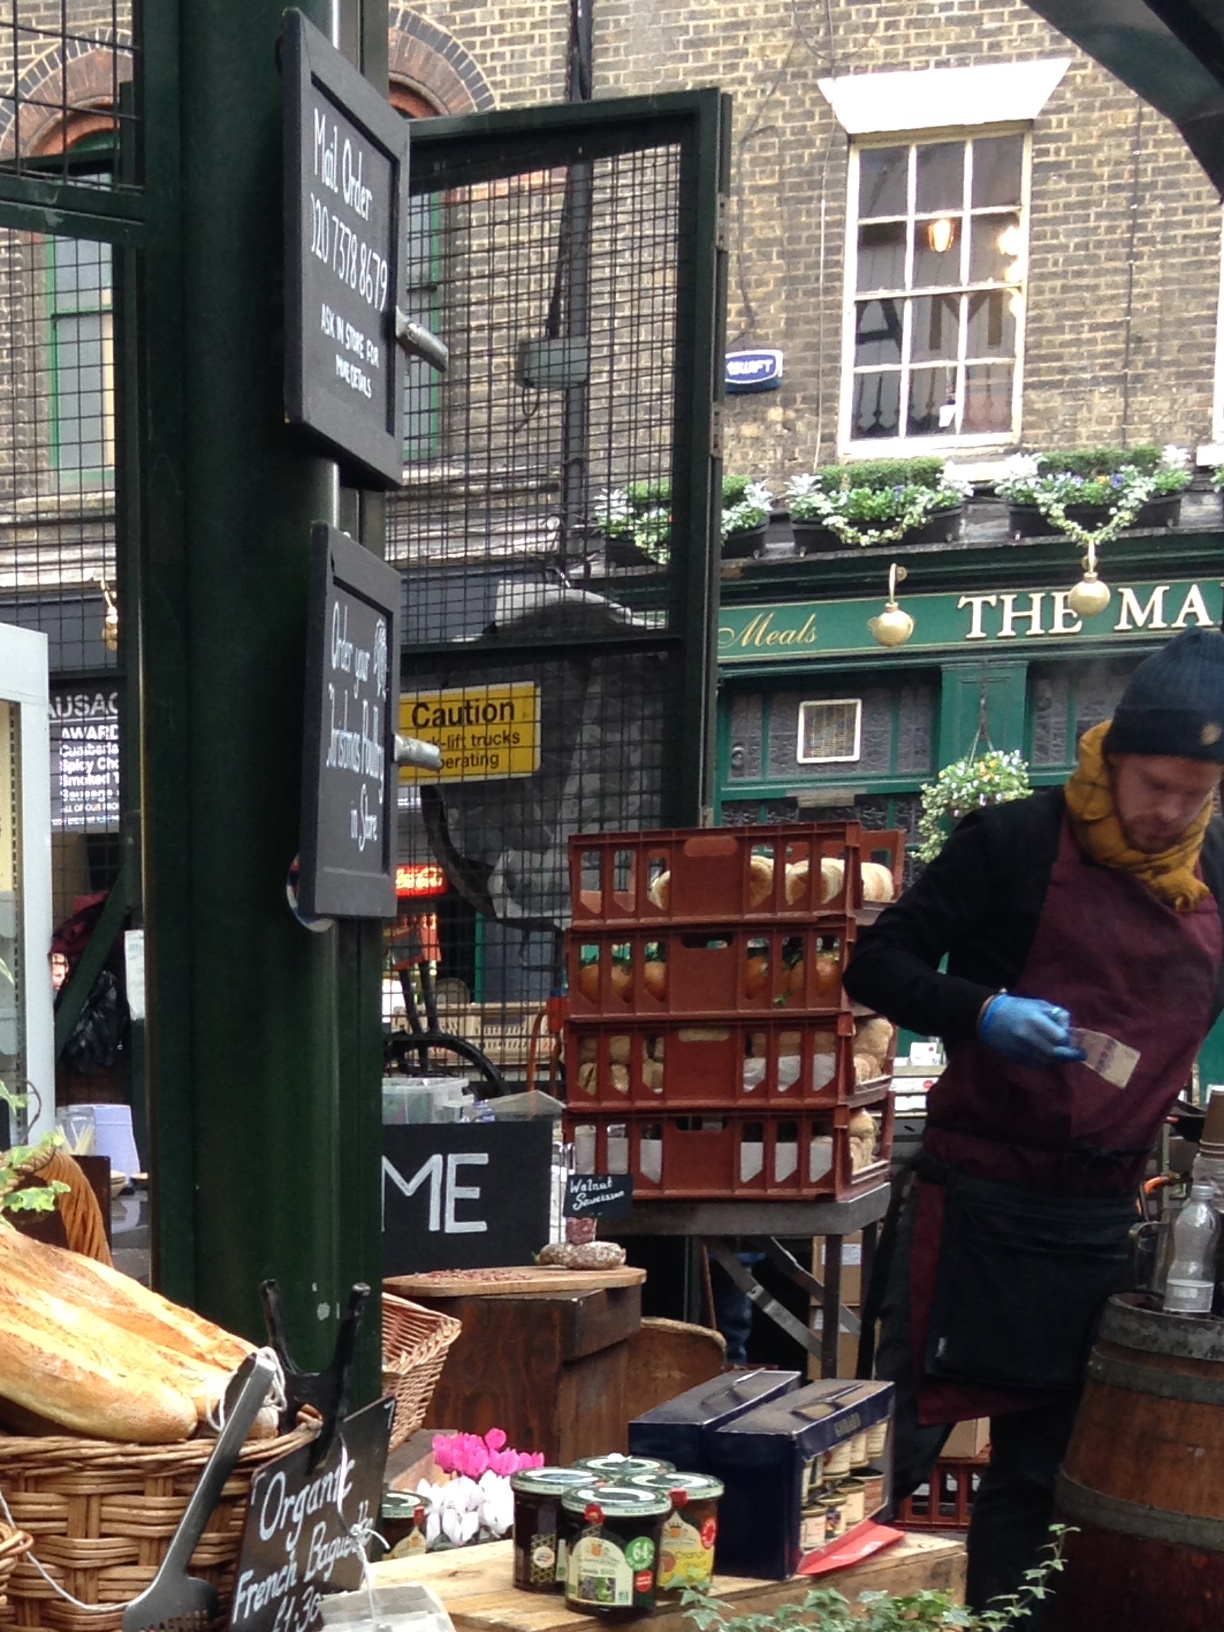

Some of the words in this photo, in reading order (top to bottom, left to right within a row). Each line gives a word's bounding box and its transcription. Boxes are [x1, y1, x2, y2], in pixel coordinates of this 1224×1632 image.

[314, 108, 339, 193] Mail
[342, 138, 373, 222] Order
[358, 242, 388, 312] 8679
[718, 612, 817, 649] Meals
[957, 593, 1083, 639] THE
[1114, 583, 1224, 631] MA
[411, 699, 515, 729] Caution
[471, 730, 520, 747] trucks
[570, 1176, 613, 1193] Walnut
[259, 1458, 355, 1551] Organic
[232, 1552, 297, 1624] French
